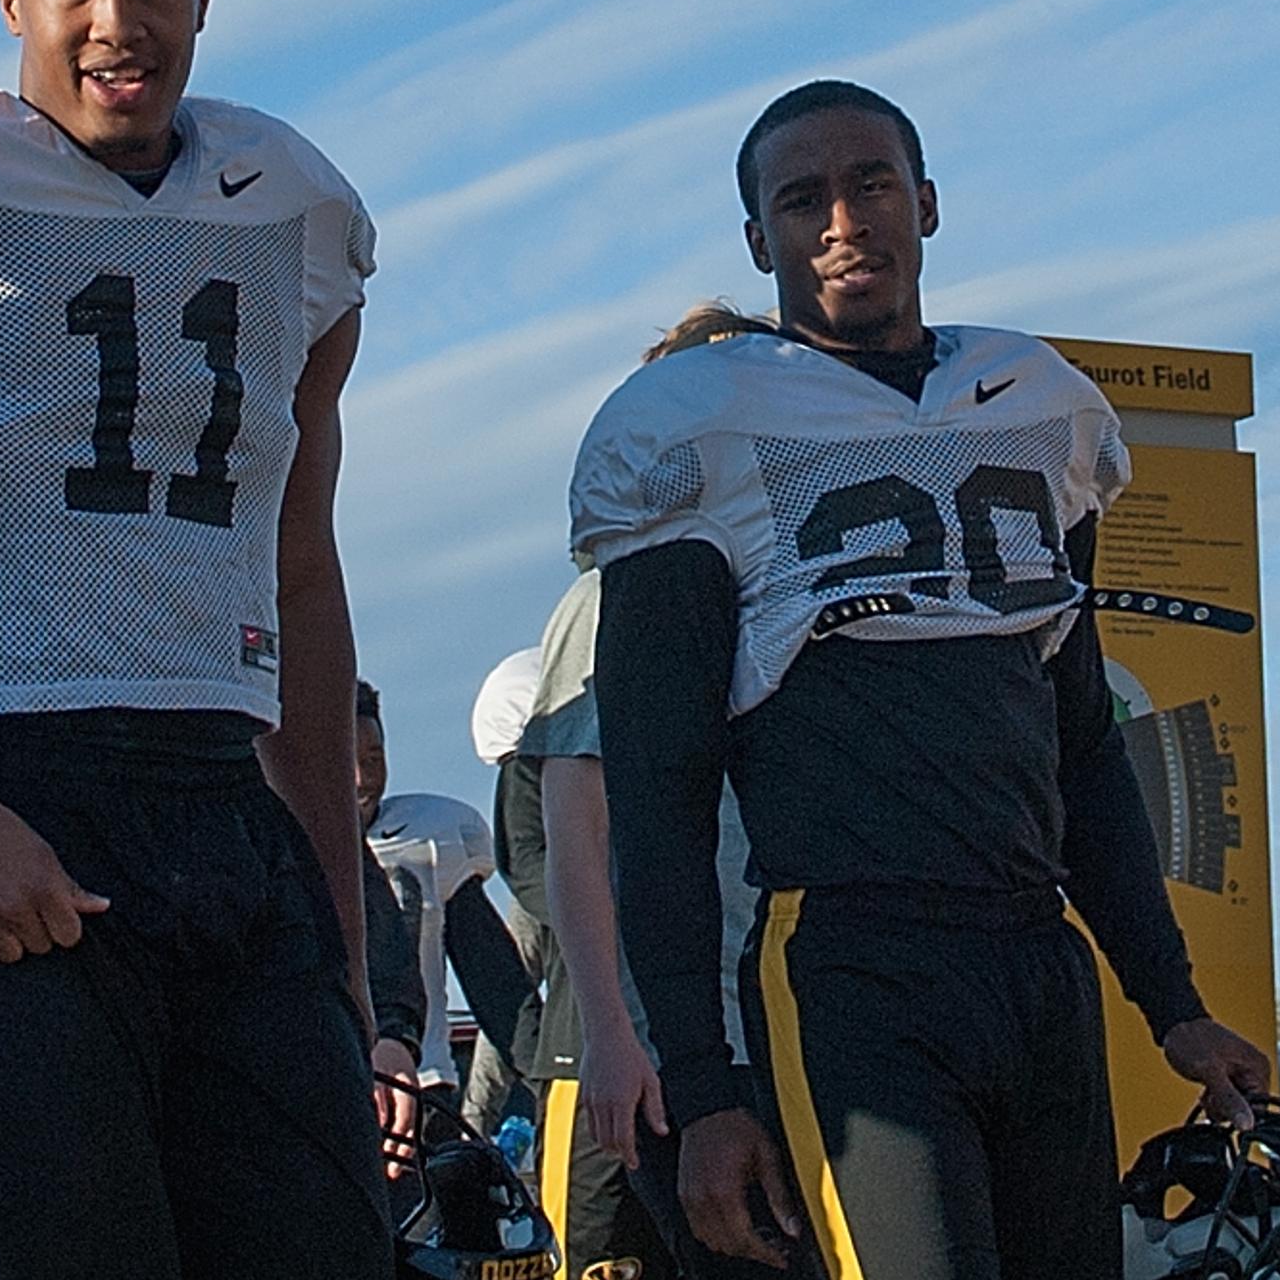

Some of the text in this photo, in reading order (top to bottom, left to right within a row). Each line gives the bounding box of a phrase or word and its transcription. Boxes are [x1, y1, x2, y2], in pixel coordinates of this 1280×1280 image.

[65, 273, 244, 529] 11
[1068, 358, 1211, 391] aurot Field
[794, 464, 1078, 615] 20
